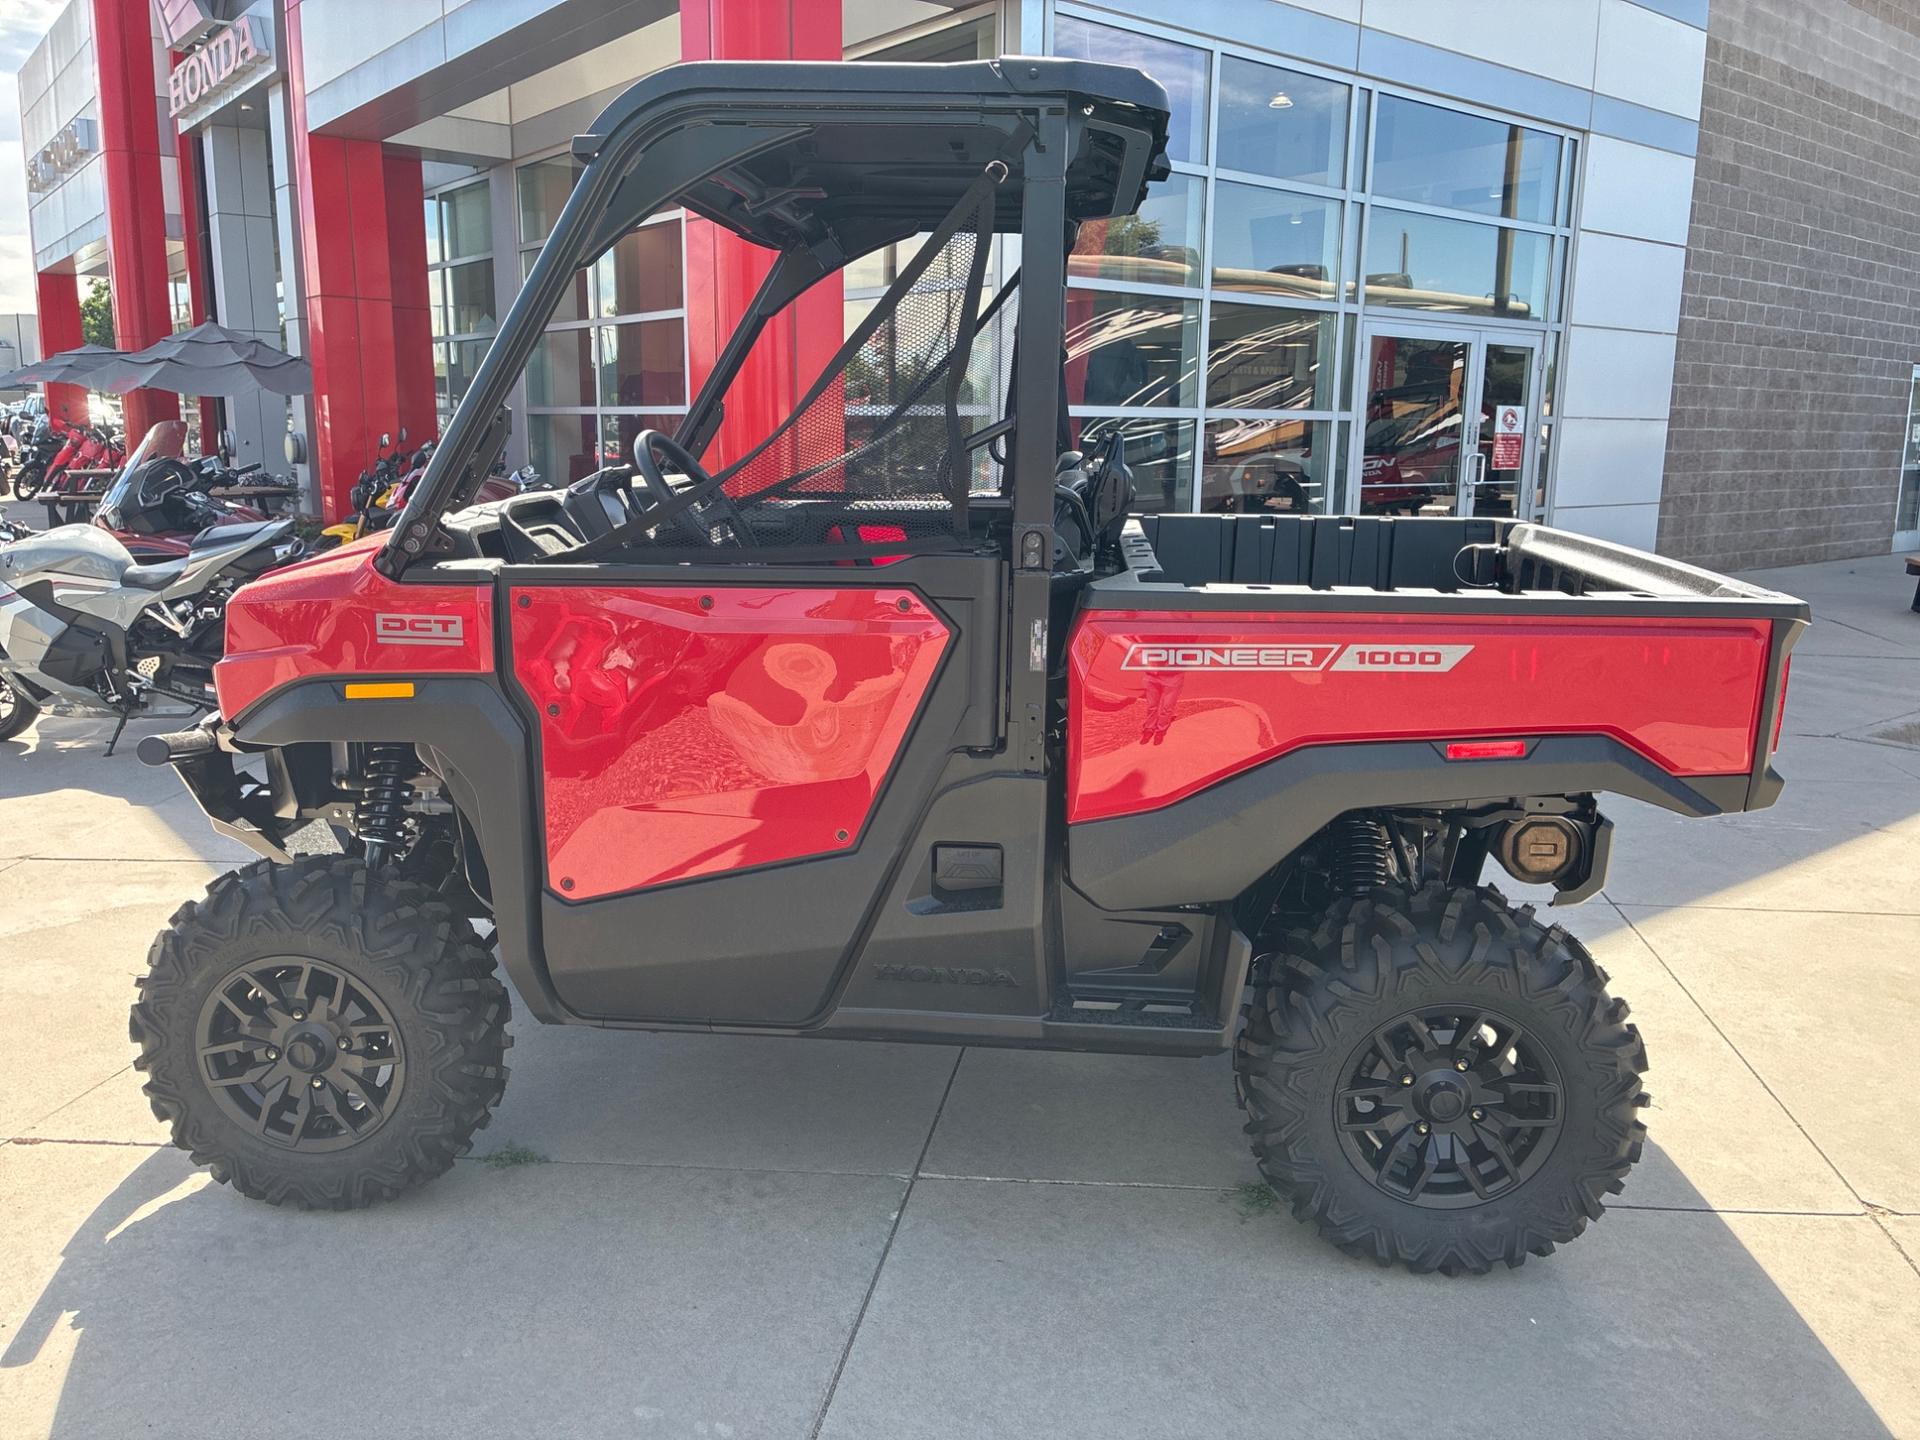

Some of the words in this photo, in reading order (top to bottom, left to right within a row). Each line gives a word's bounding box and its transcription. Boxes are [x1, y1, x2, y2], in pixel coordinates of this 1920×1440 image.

[168, 15, 257, 118] HONDA
[382, 617, 457, 633] DCT
[1140, 649, 1314, 666] PIONEER
[1354, 651, 1442, 665] 1000
[873, 963, 1020, 988] HONDA
